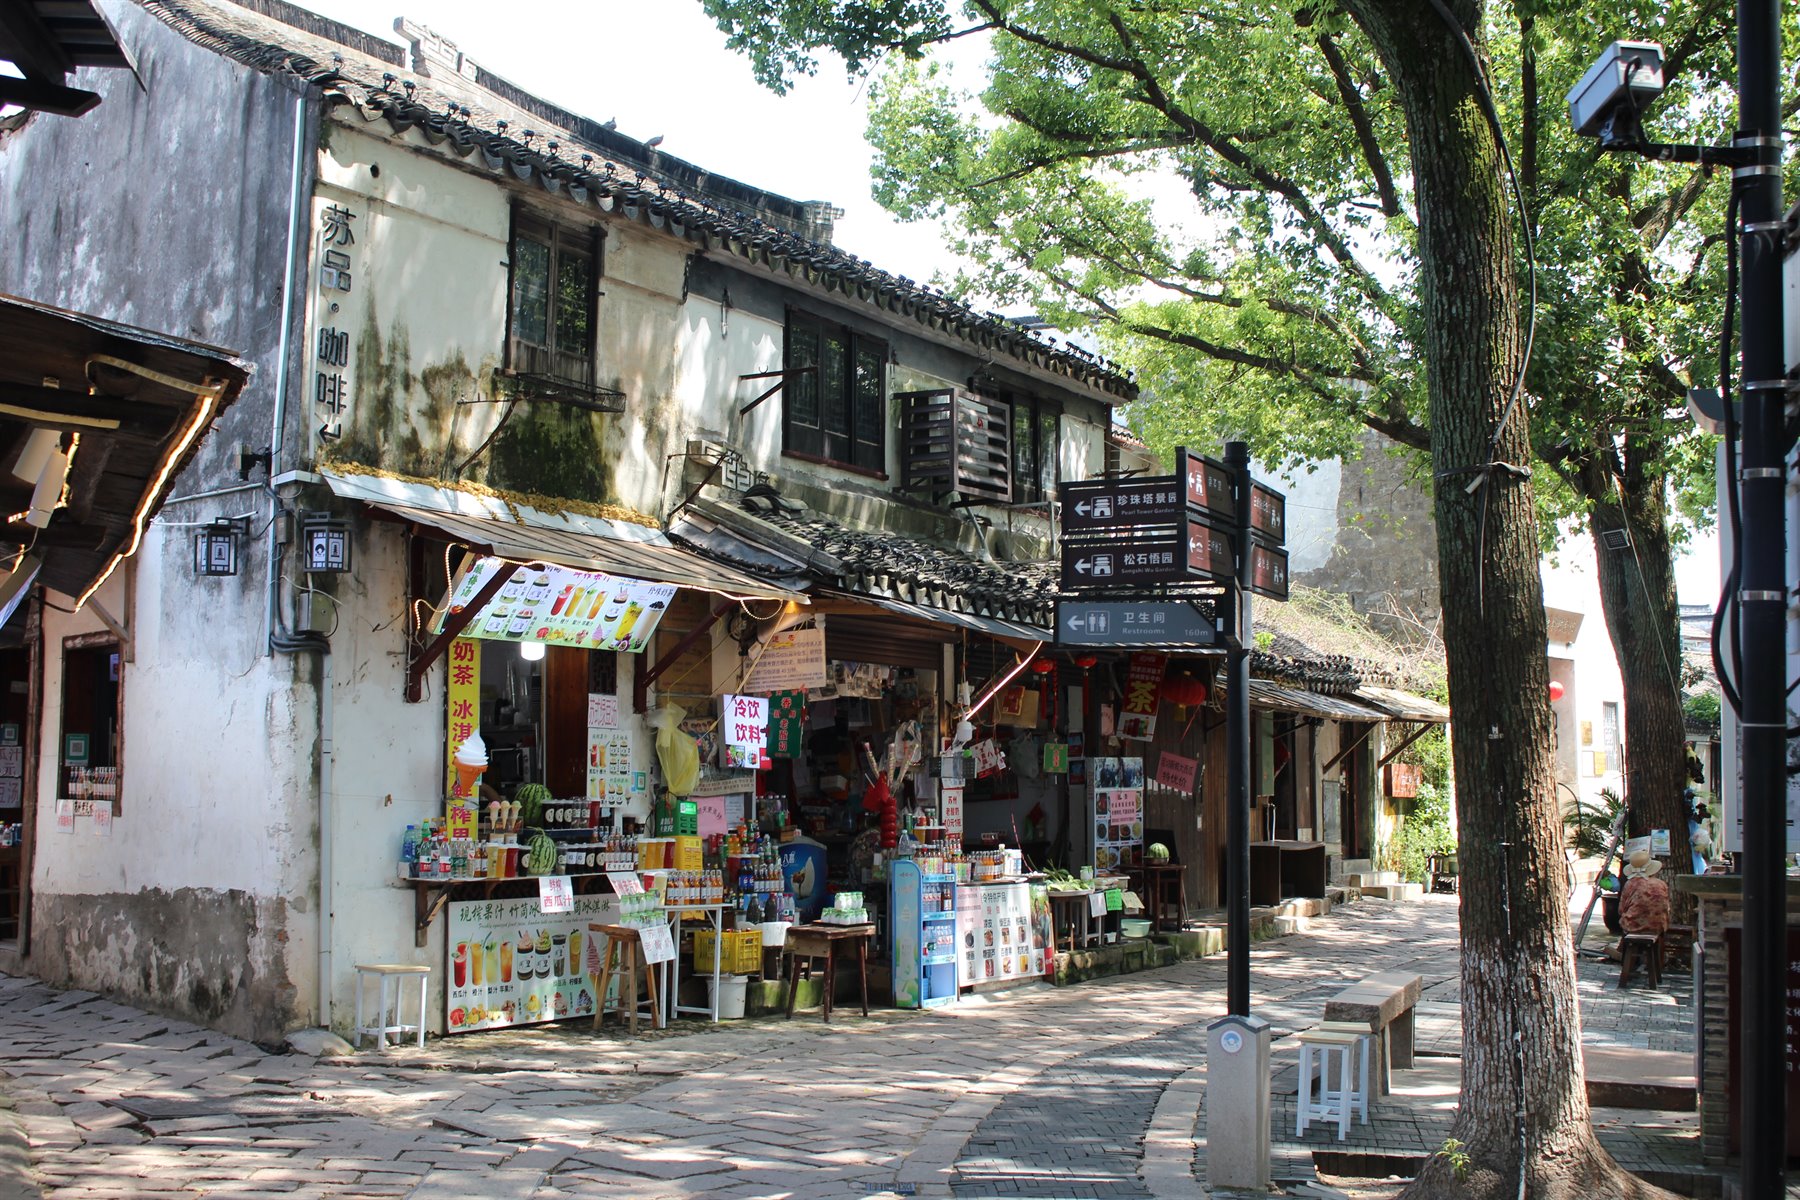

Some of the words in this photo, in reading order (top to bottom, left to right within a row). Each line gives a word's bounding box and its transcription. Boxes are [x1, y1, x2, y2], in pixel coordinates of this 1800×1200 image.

[1117, 492, 1177, 506] 珍珠塔景园
[1123, 552, 1173, 565] 松石悟园
[1123, 612, 1165, 624] 卫生间
[453, 642, 474, 685] 奶茶
[1126, 680, 1156, 713] 茶
[734, 698, 761, 720] 冷饮
[735, 723, 761, 744] 饮料
[544, 894, 572, 908] 西瓜汁
[452, 989, 467, 998] 西瓜汁
